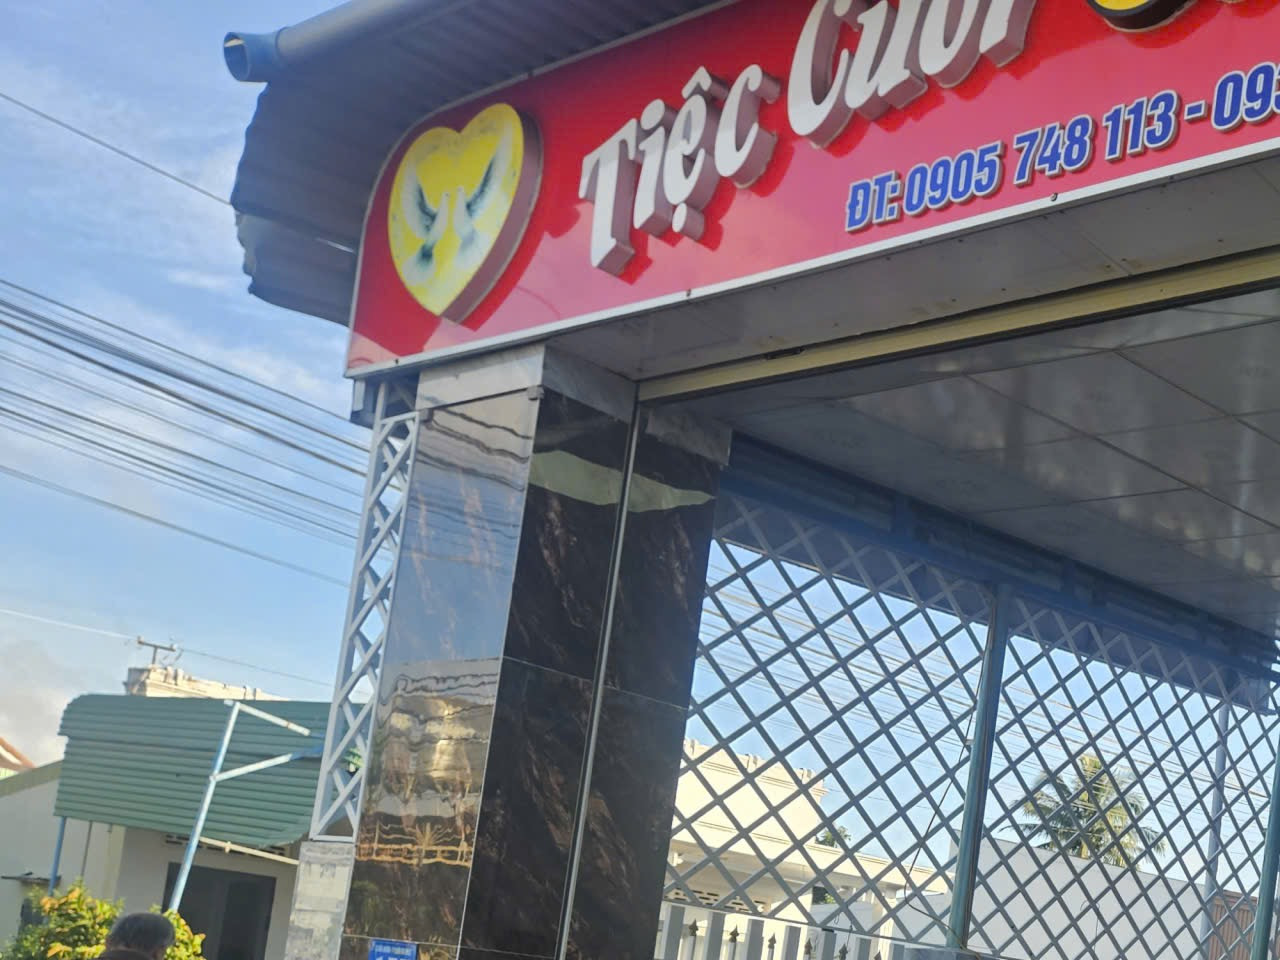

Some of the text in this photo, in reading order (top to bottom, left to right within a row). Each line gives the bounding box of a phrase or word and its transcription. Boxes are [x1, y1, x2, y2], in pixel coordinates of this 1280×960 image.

[579, 64, 764, 268] Tiệc
[904, 141, 1002, 216] 0905
[1013, 115, 1094, 185] 748
[1102, 90, 1178, 161] 113
